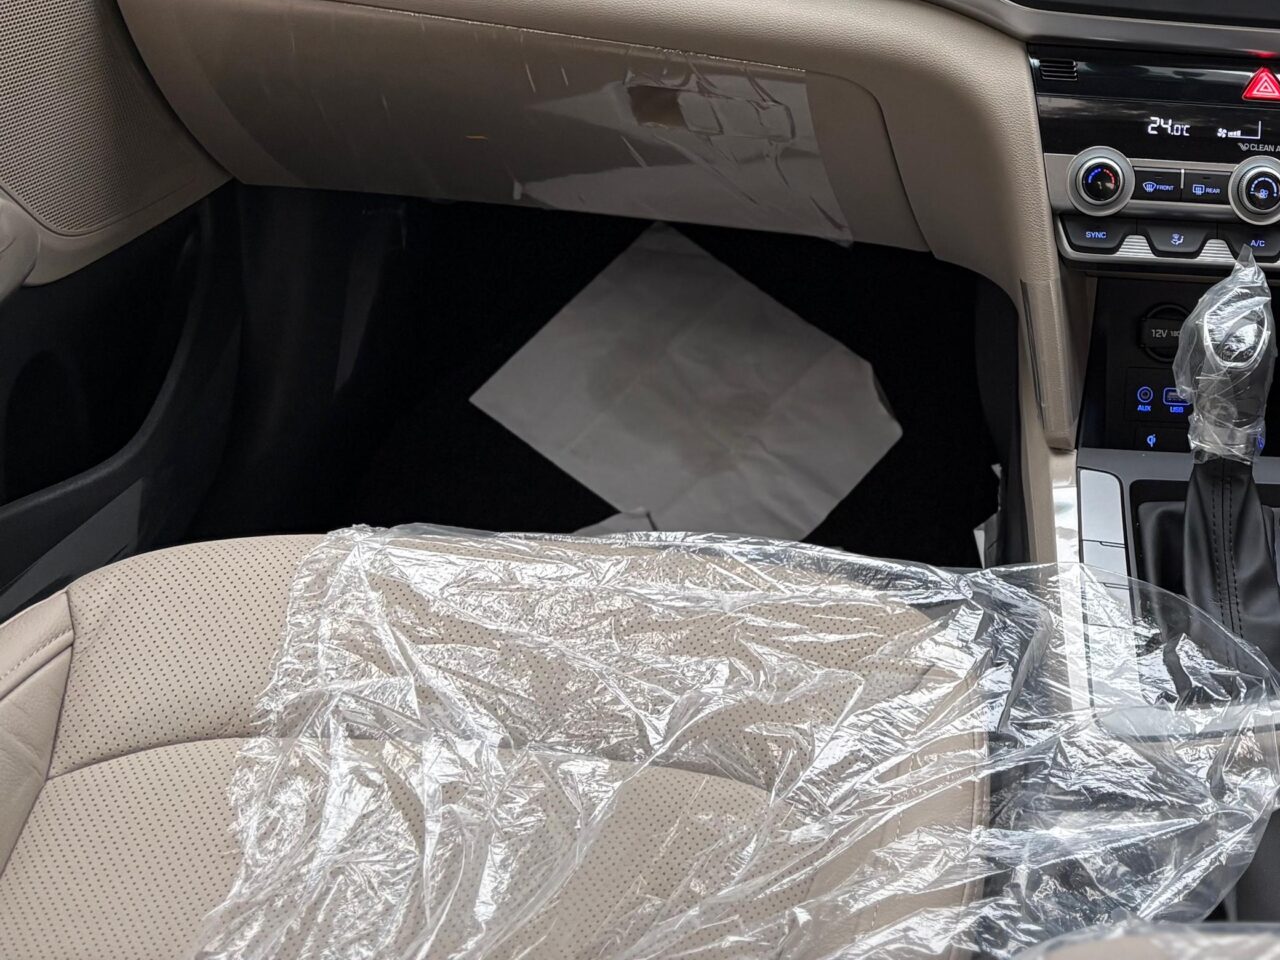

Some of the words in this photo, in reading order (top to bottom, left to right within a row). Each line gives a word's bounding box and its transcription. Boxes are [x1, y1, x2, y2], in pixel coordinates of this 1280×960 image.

[1249, 143, 1275, 153] CLEAN
[1156, 183, 1176, 192] FRONT
[1205, 186, 1221, 195] REAR
[1085, 231, 1107, 239] SYNC
[1250, 239, 1265, 248] A/C
[1151, 329, 1168, 338] 12V
[1137, 404, 1152, 412] AUX
[1169, 406, 1184, 414] USB
